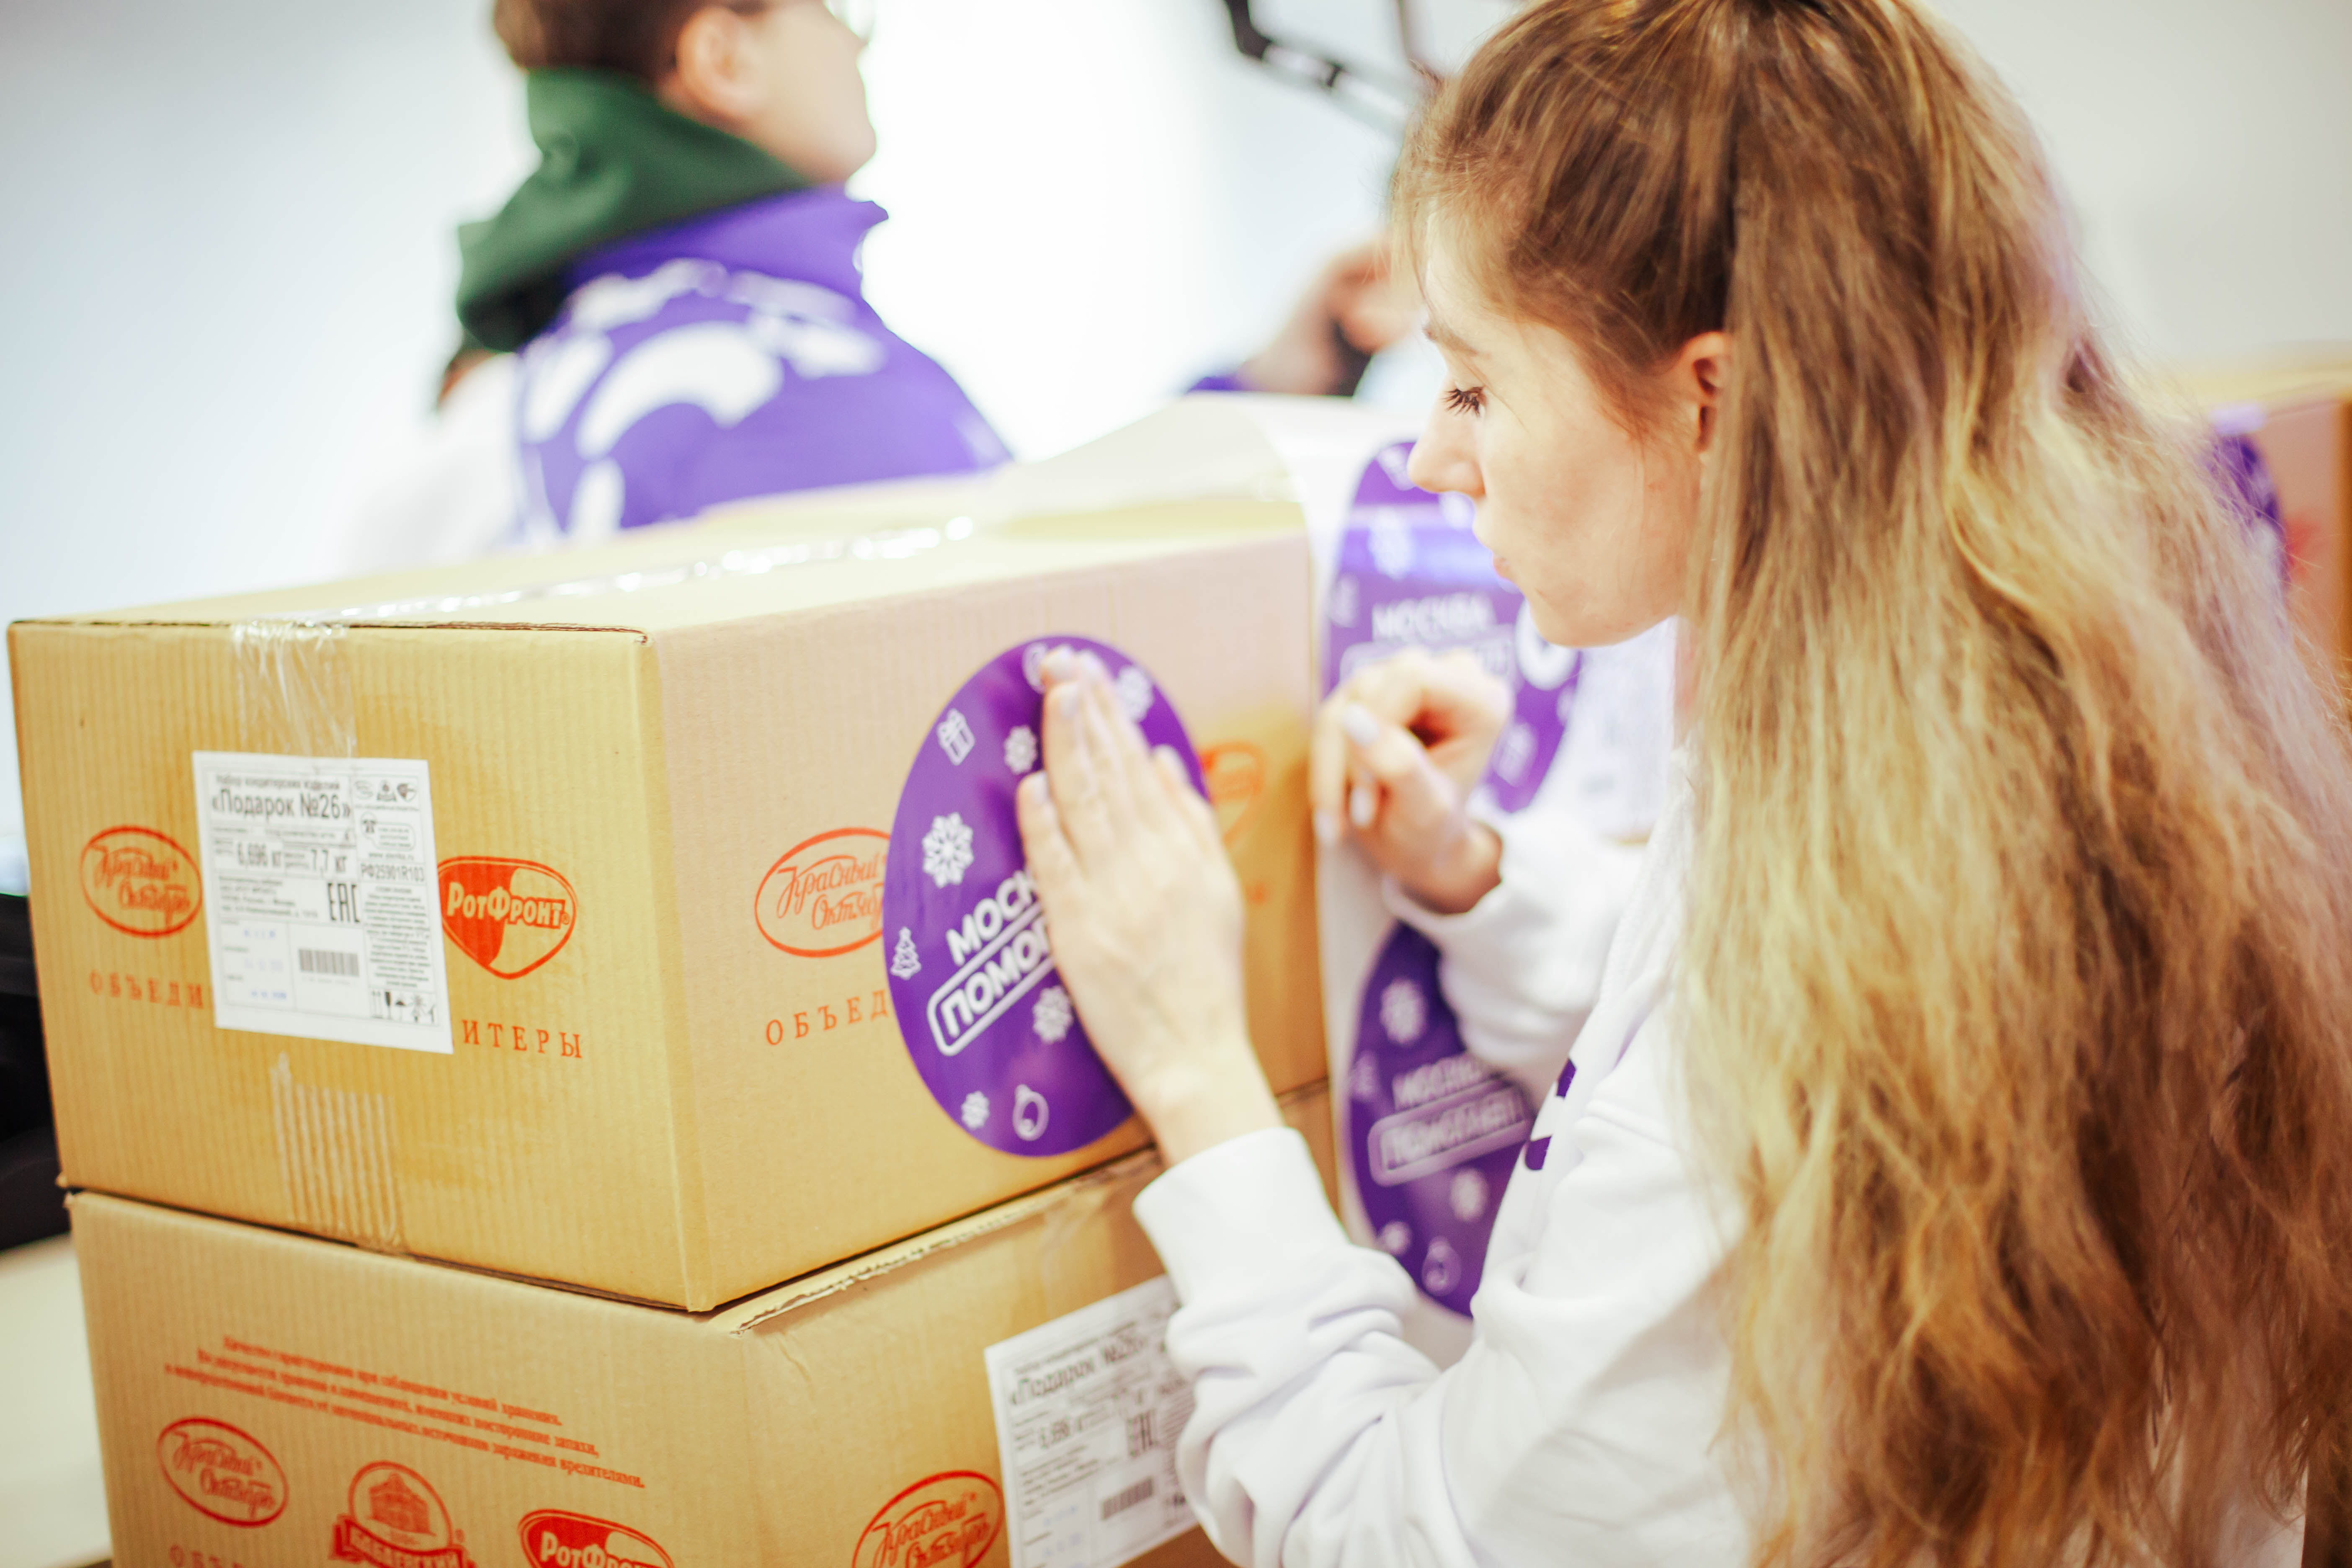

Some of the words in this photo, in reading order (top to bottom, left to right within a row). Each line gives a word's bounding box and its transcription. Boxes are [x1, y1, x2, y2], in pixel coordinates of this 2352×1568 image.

[212, 788, 295, 823] «Подарок
[945, 869, 1039, 967] МОСК
[89, 968, 204, 1009] ОБЪЕДИ
[940, 916, 1050, 1038] ПОМОГ
[462, 1019, 583, 1059] ИТЕРЫ
[766, 990, 888, 1045] ОБЪЕД
